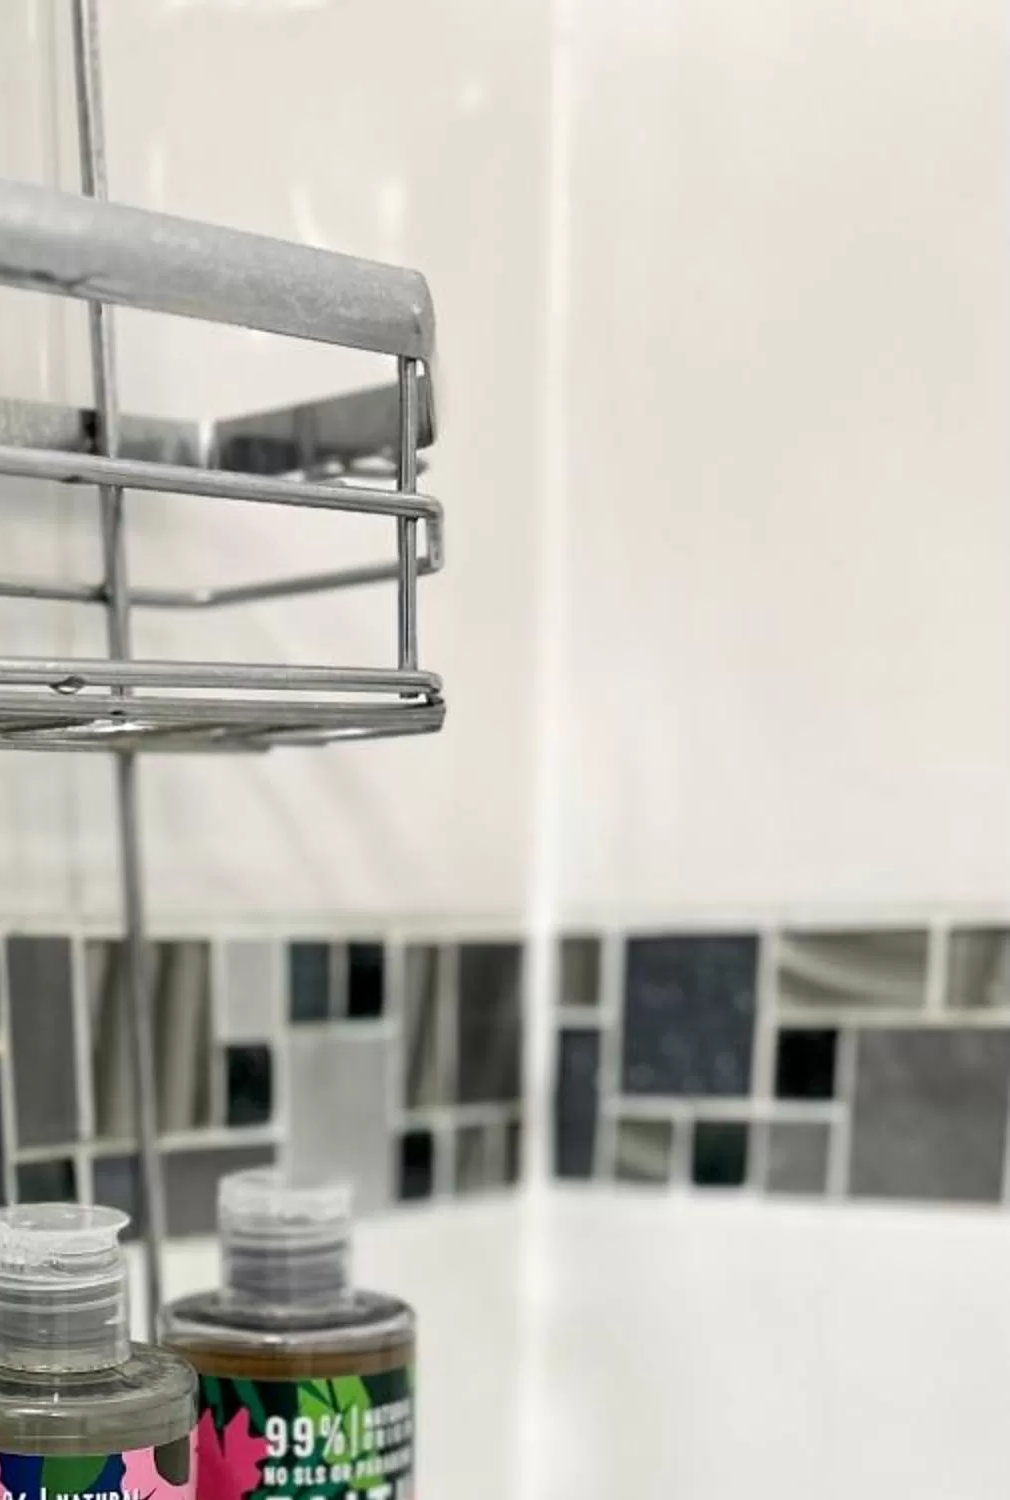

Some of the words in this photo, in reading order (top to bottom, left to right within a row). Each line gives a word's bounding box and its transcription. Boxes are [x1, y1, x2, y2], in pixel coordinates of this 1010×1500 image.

[265, 1412, 345, 1458] 99%
[263, 1466, 288, 1486] NO
[293, 1465, 327, 1486] SLS
